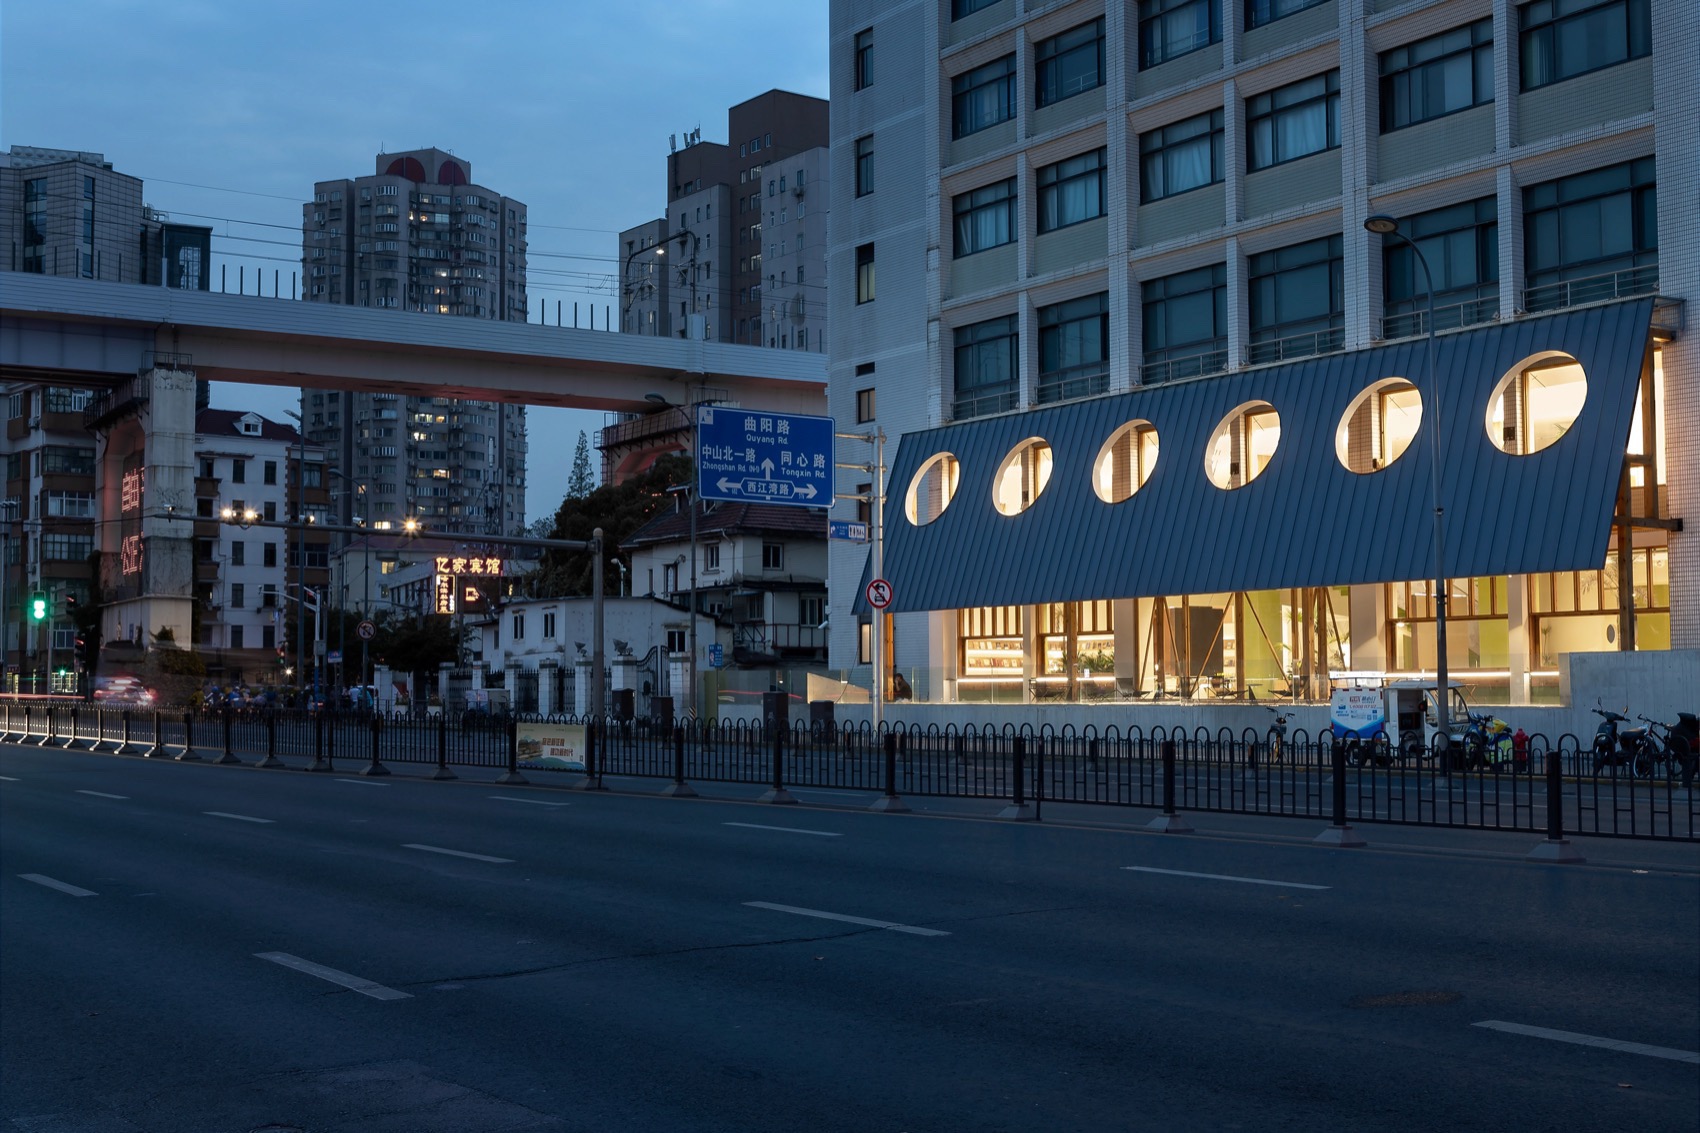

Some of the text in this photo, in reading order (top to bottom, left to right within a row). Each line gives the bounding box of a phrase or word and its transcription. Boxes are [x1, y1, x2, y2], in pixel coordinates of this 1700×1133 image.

[744, 416, 790, 435] 曲阳路
[746, 434, 789, 446] Quyang Rd.
[702, 444, 756, 463] 中山北一路
[781, 451, 826, 469] 同心路
[702, 462, 736, 473] Zhongshan
[782, 468, 826, 479] Tongxin Rd.
[747, 481, 789, 495] 西江湾路
[436, 557, 500, 574] 亿家宾馆
